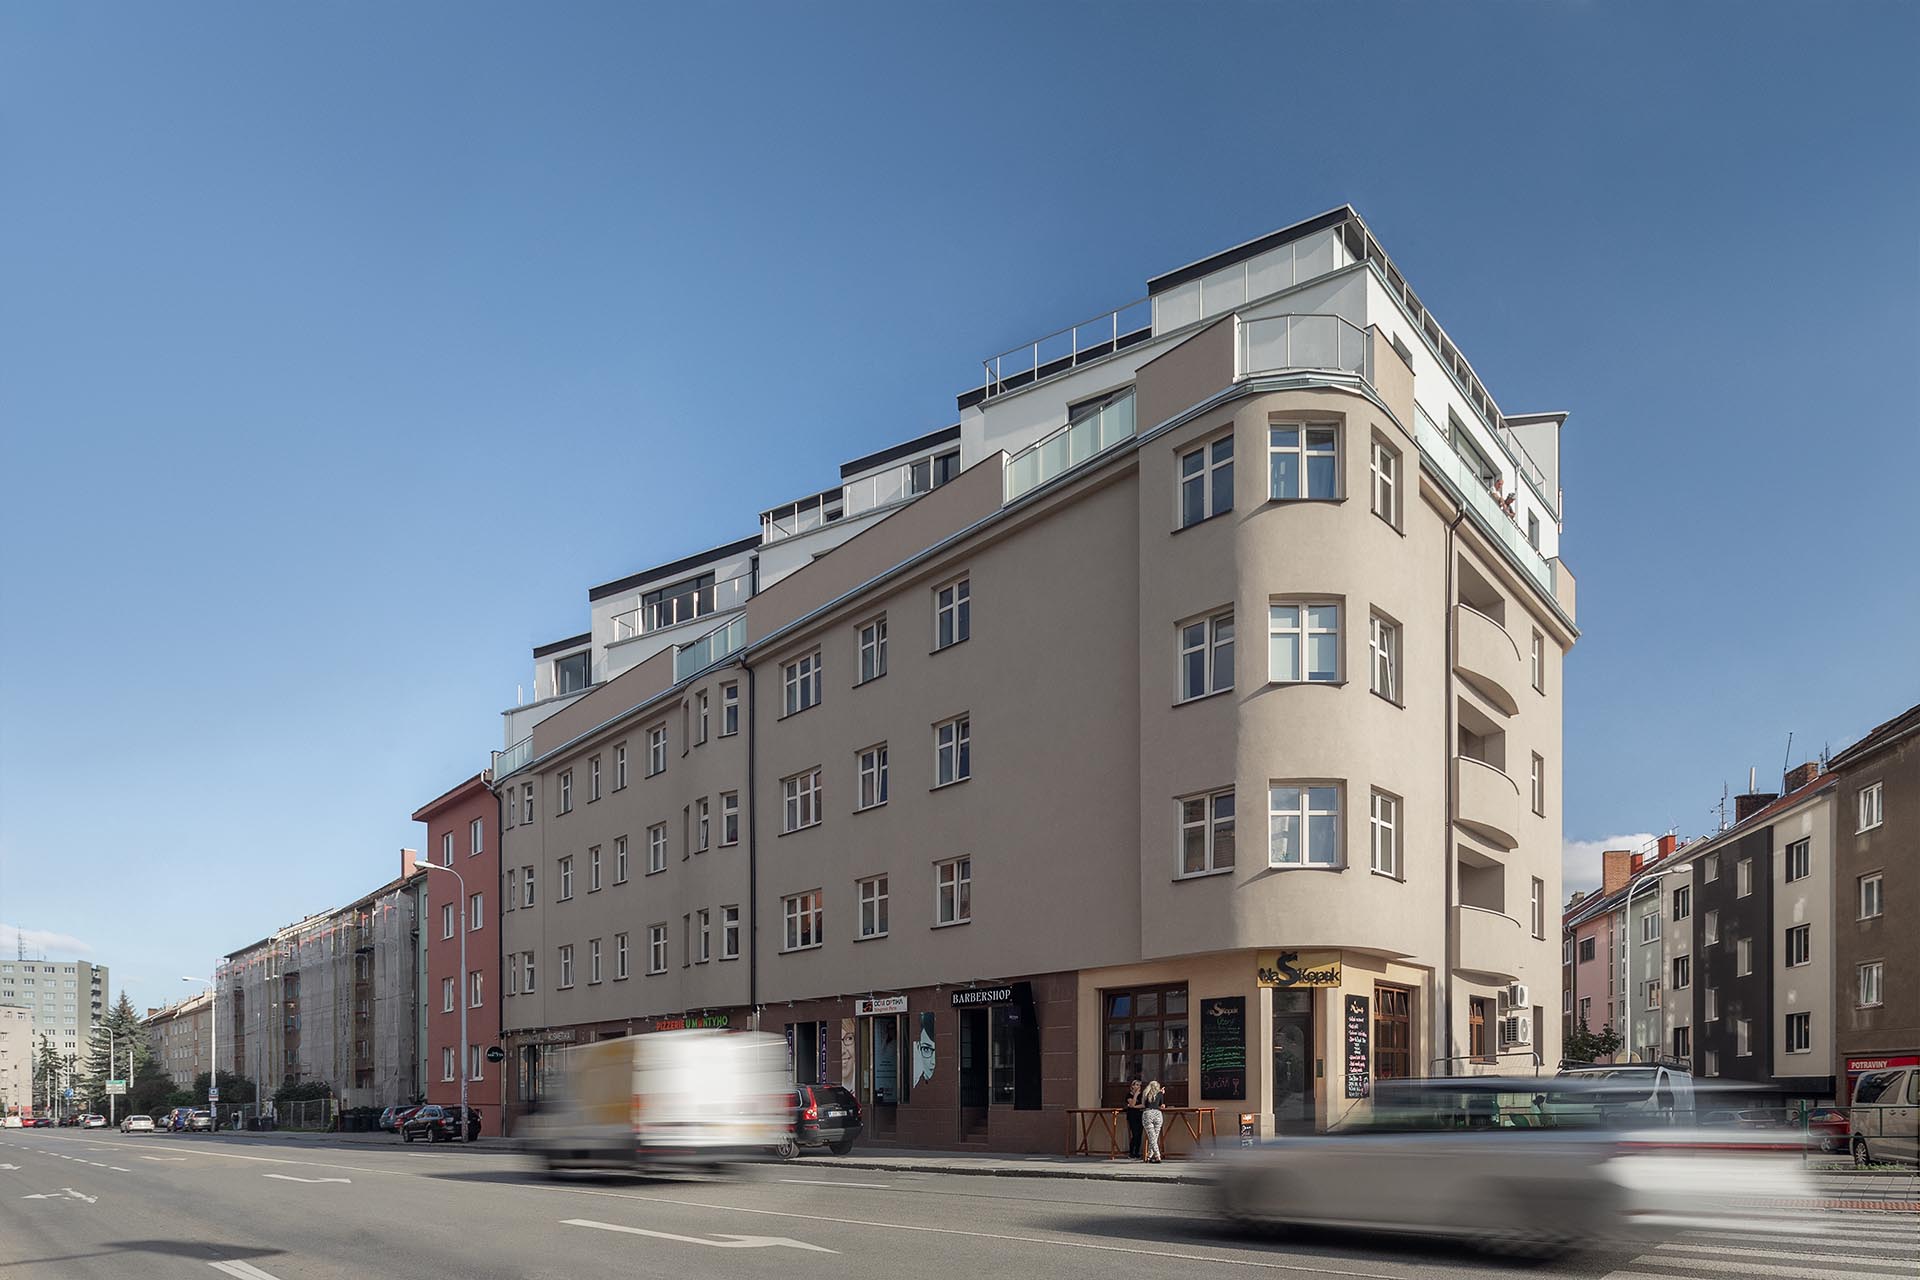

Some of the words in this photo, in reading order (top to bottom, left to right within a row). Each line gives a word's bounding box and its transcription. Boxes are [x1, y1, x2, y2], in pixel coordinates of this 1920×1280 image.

[952, 989, 1011, 1004] BARBERSHOP
[656, 1020, 684, 1031] PIZZERIE
[685, 1018, 691, 1028] U
[1851, 1060, 1887, 1069] POTRAVINY
